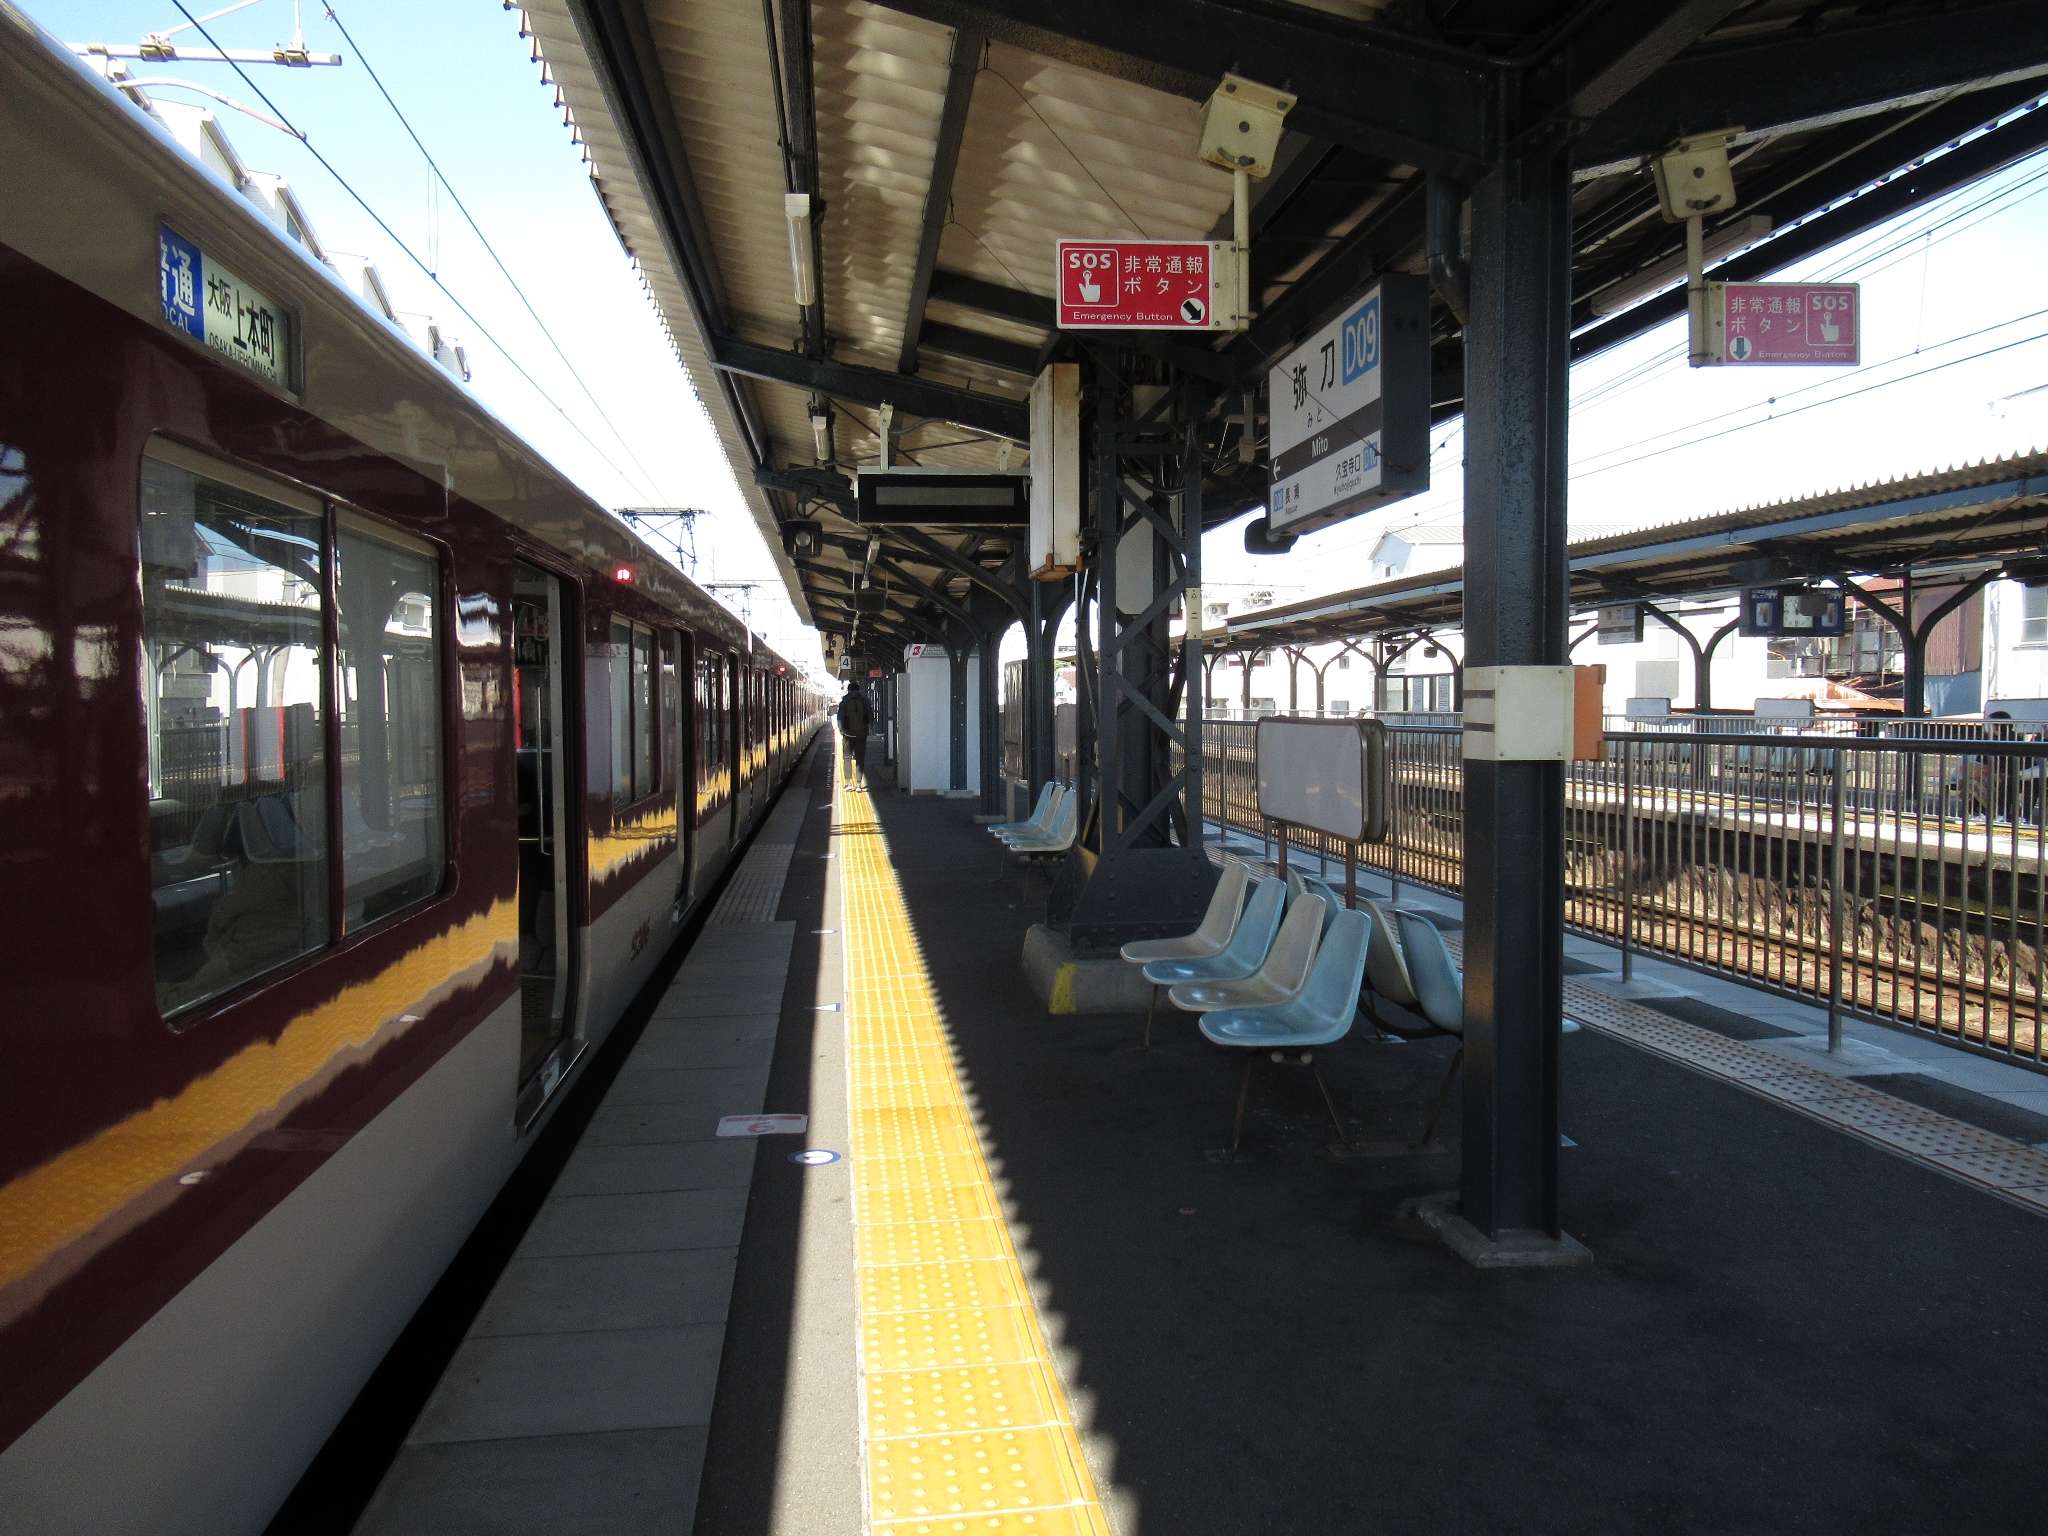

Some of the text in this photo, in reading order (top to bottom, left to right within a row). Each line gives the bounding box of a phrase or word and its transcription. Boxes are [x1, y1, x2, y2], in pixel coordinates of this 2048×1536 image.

[1069, 252, 1112, 270] SOS
[1124, 255, 1204, 274] 非常通報
[1731, 296, 1801, 314] 非常通報
[1812, 295, 1849, 311] SOS
[1073, 311, 1173, 322] Emergency Button
[1345, 308, 1377, 377] D09
[1758, 350, 1847, 360] Emergency Button
[1293, 339, 1335, 411] 弥刀
[1311, 436, 1329, 458] Mito
[1335, 454, 1361, 482] 久宝寺口
[842, 658, 849, 668] 4
